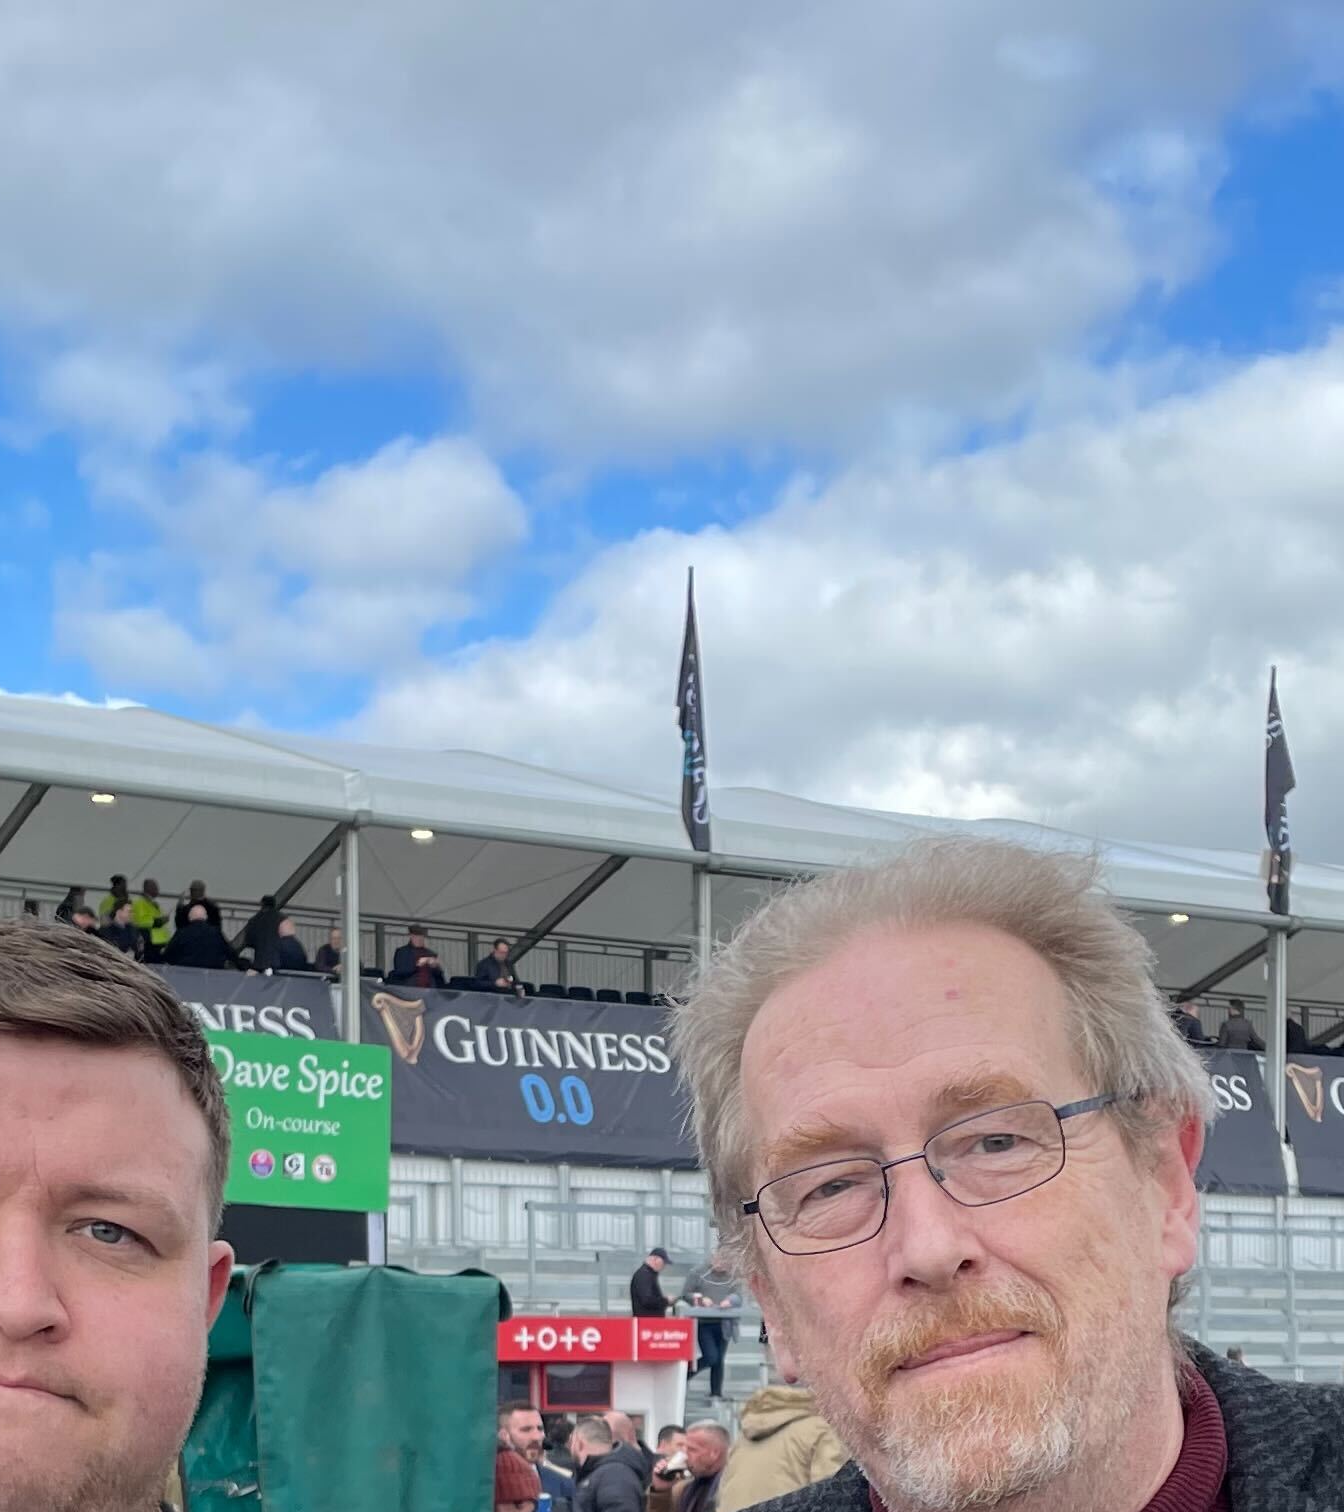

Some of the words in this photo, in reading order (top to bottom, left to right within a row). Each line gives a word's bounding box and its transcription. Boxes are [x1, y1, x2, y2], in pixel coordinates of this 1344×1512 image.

[433, 1015, 672, 1073] GUINNESS
[297, 1054, 384, 1109] Spice
[520, 1073, 594, 1126] 0.0
[245, 1106, 341, 1137] On-course
[513, 1326, 602, 1352] tote
